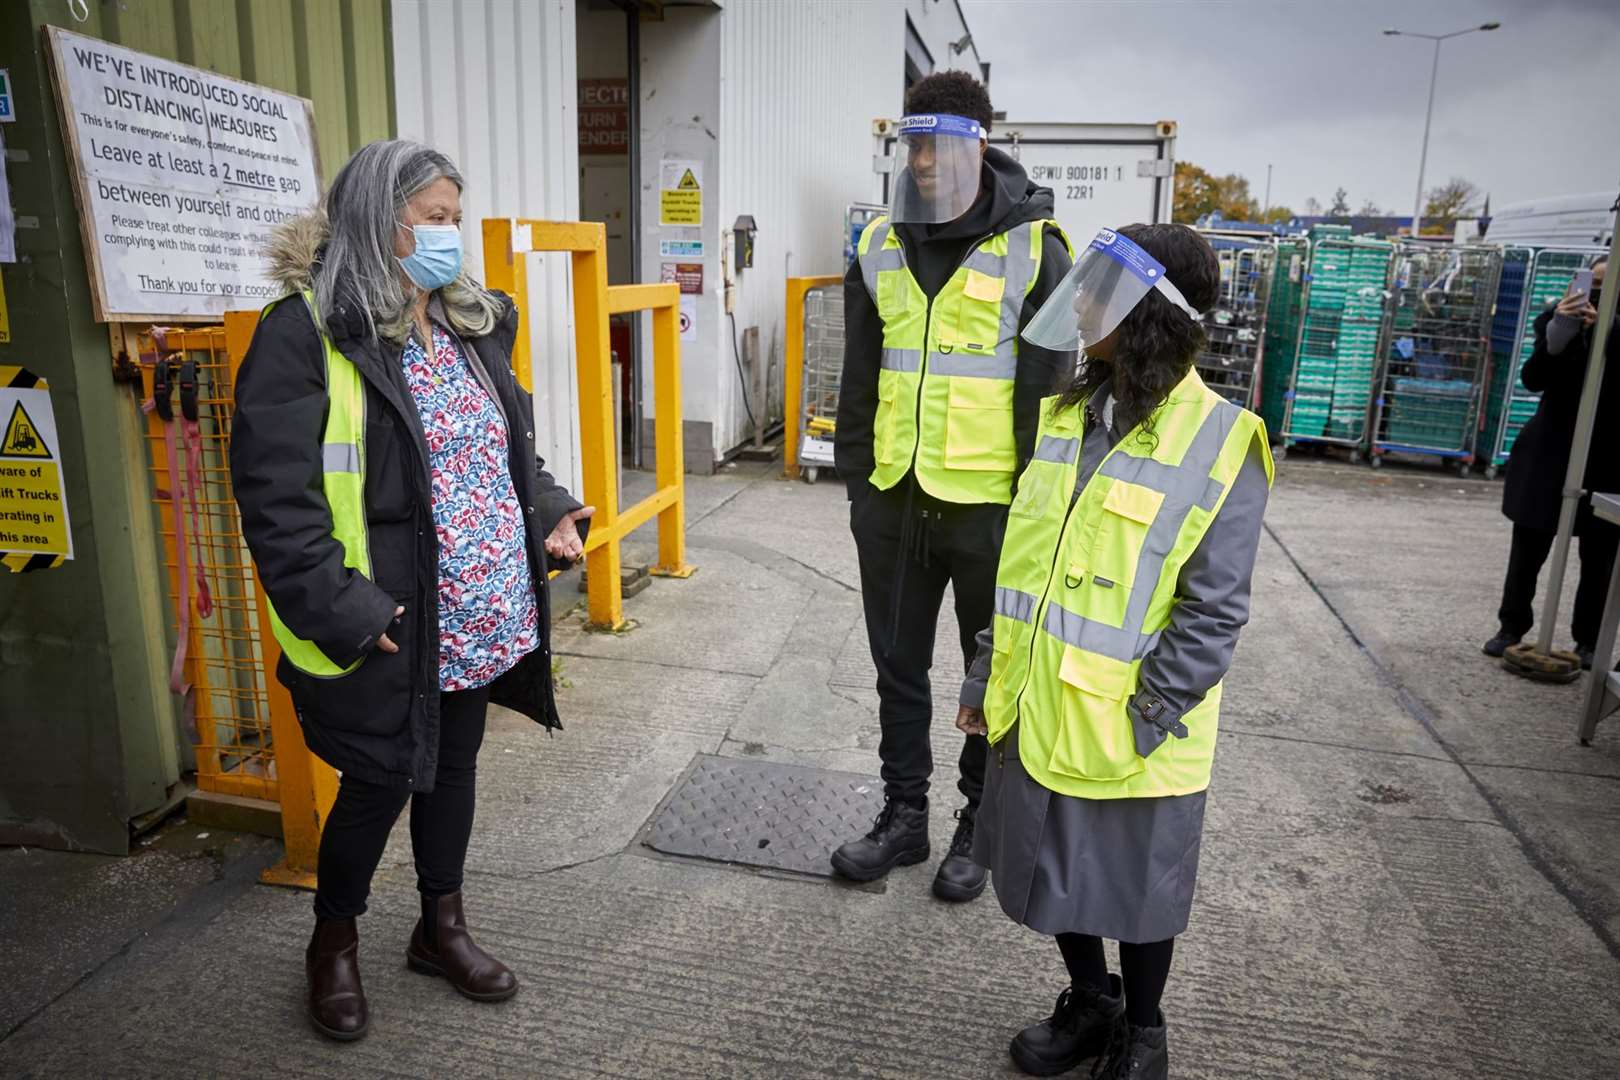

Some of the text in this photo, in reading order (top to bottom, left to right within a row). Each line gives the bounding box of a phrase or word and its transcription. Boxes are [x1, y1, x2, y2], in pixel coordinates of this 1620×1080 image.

[73, 47, 288, 120] WE'VE INTRODUCED SOCIAL
[104, 86, 277, 142] DISTANCING MEASURES
[909, 117, 934, 126] Shield
[80, 112, 102, 127] This
[104, 117, 112, 129] is
[114, 119, 128, 132] for
[130, 125, 177, 142] everyone's
[207, 140, 237, 154] comfort
[238, 147, 250, 158] and
[251, 150, 271, 160] peace
[272, 154, 279, 162] of
[91, 138, 301, 195] Leave at least a 2 metre gap
[1032, 166, 1062, 180] SPWU
[1066, 166, 1108, 180] 900181
[98, 180, 171, 209] between
[174, 195, 231, 217] yourself
[236, 206, 260, 221] and
[1066, 185, 1093, 199] 22R1
[111, 214, 144, 229] Please
[146, 219, 170, 233] treat
[172, 222, 195, 236] other
[199, 226, 241, 241] colleagues
[104, 233, 156, 250] complying
[158, 237, 178, 250] with
[180, 239, 196, 252] this
[198, 242, 221, 255] could
[204, 259, 214, 271] to
[138, 274, 176, 292] Thank
[177, 280, 198, 295] you
[201, 278, 216, 293] for
[30, 467, 42, 477] of
[17, 488, 59, 501] Trucks
[43, 512, 55, 523] in
[23, 535, 49, 544] area
